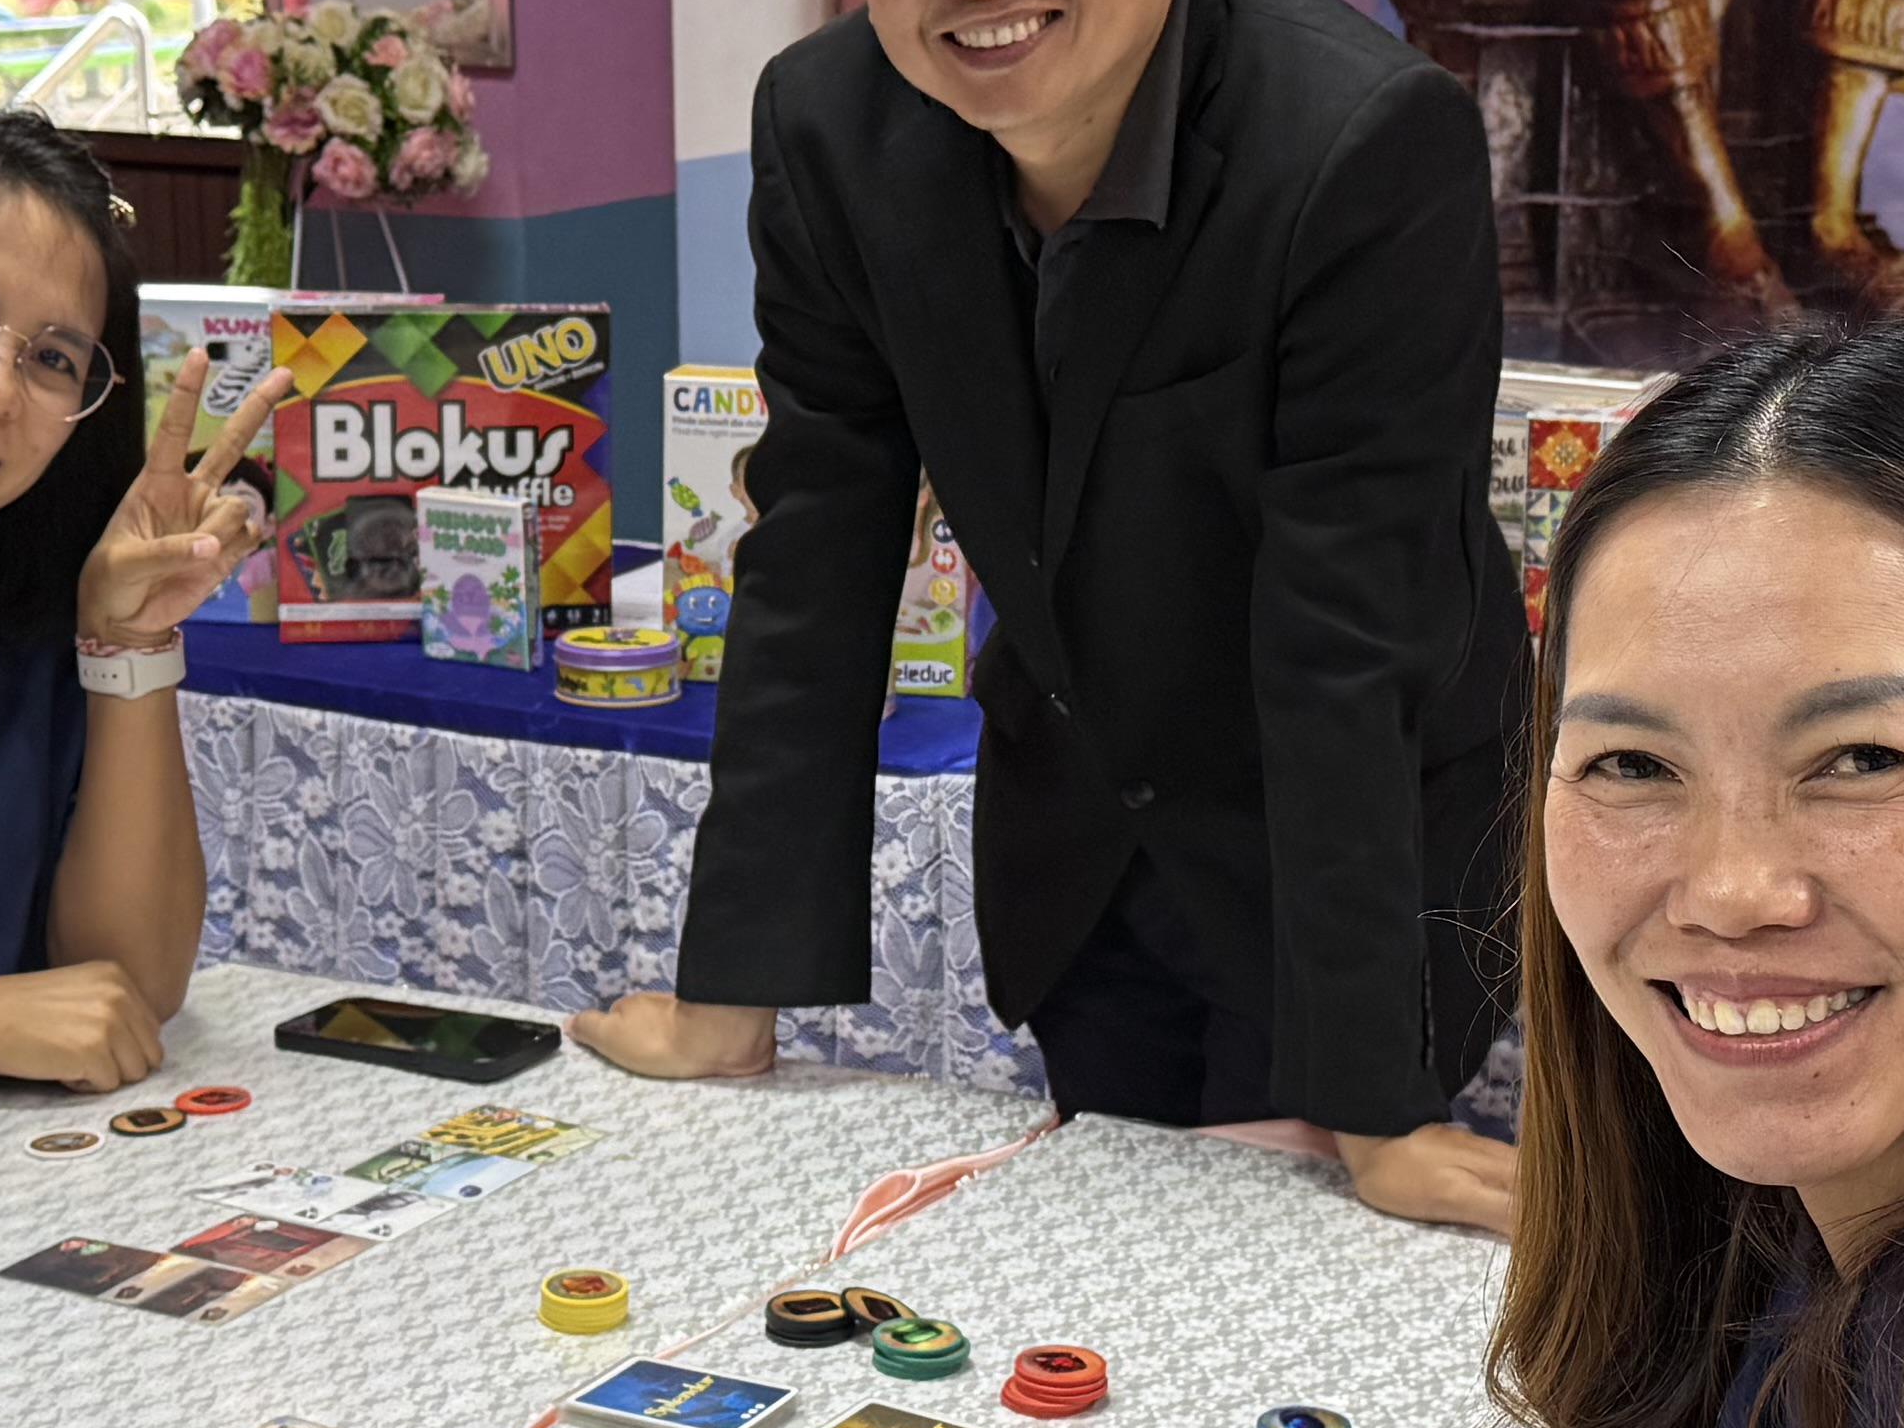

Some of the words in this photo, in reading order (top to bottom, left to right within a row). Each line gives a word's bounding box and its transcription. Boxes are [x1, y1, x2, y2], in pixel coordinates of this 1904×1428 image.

[482, 319, 594, 390] UNO
[312, 401, 573, 484] Blokus
[643, 1375, 715, 1417] Splendor
